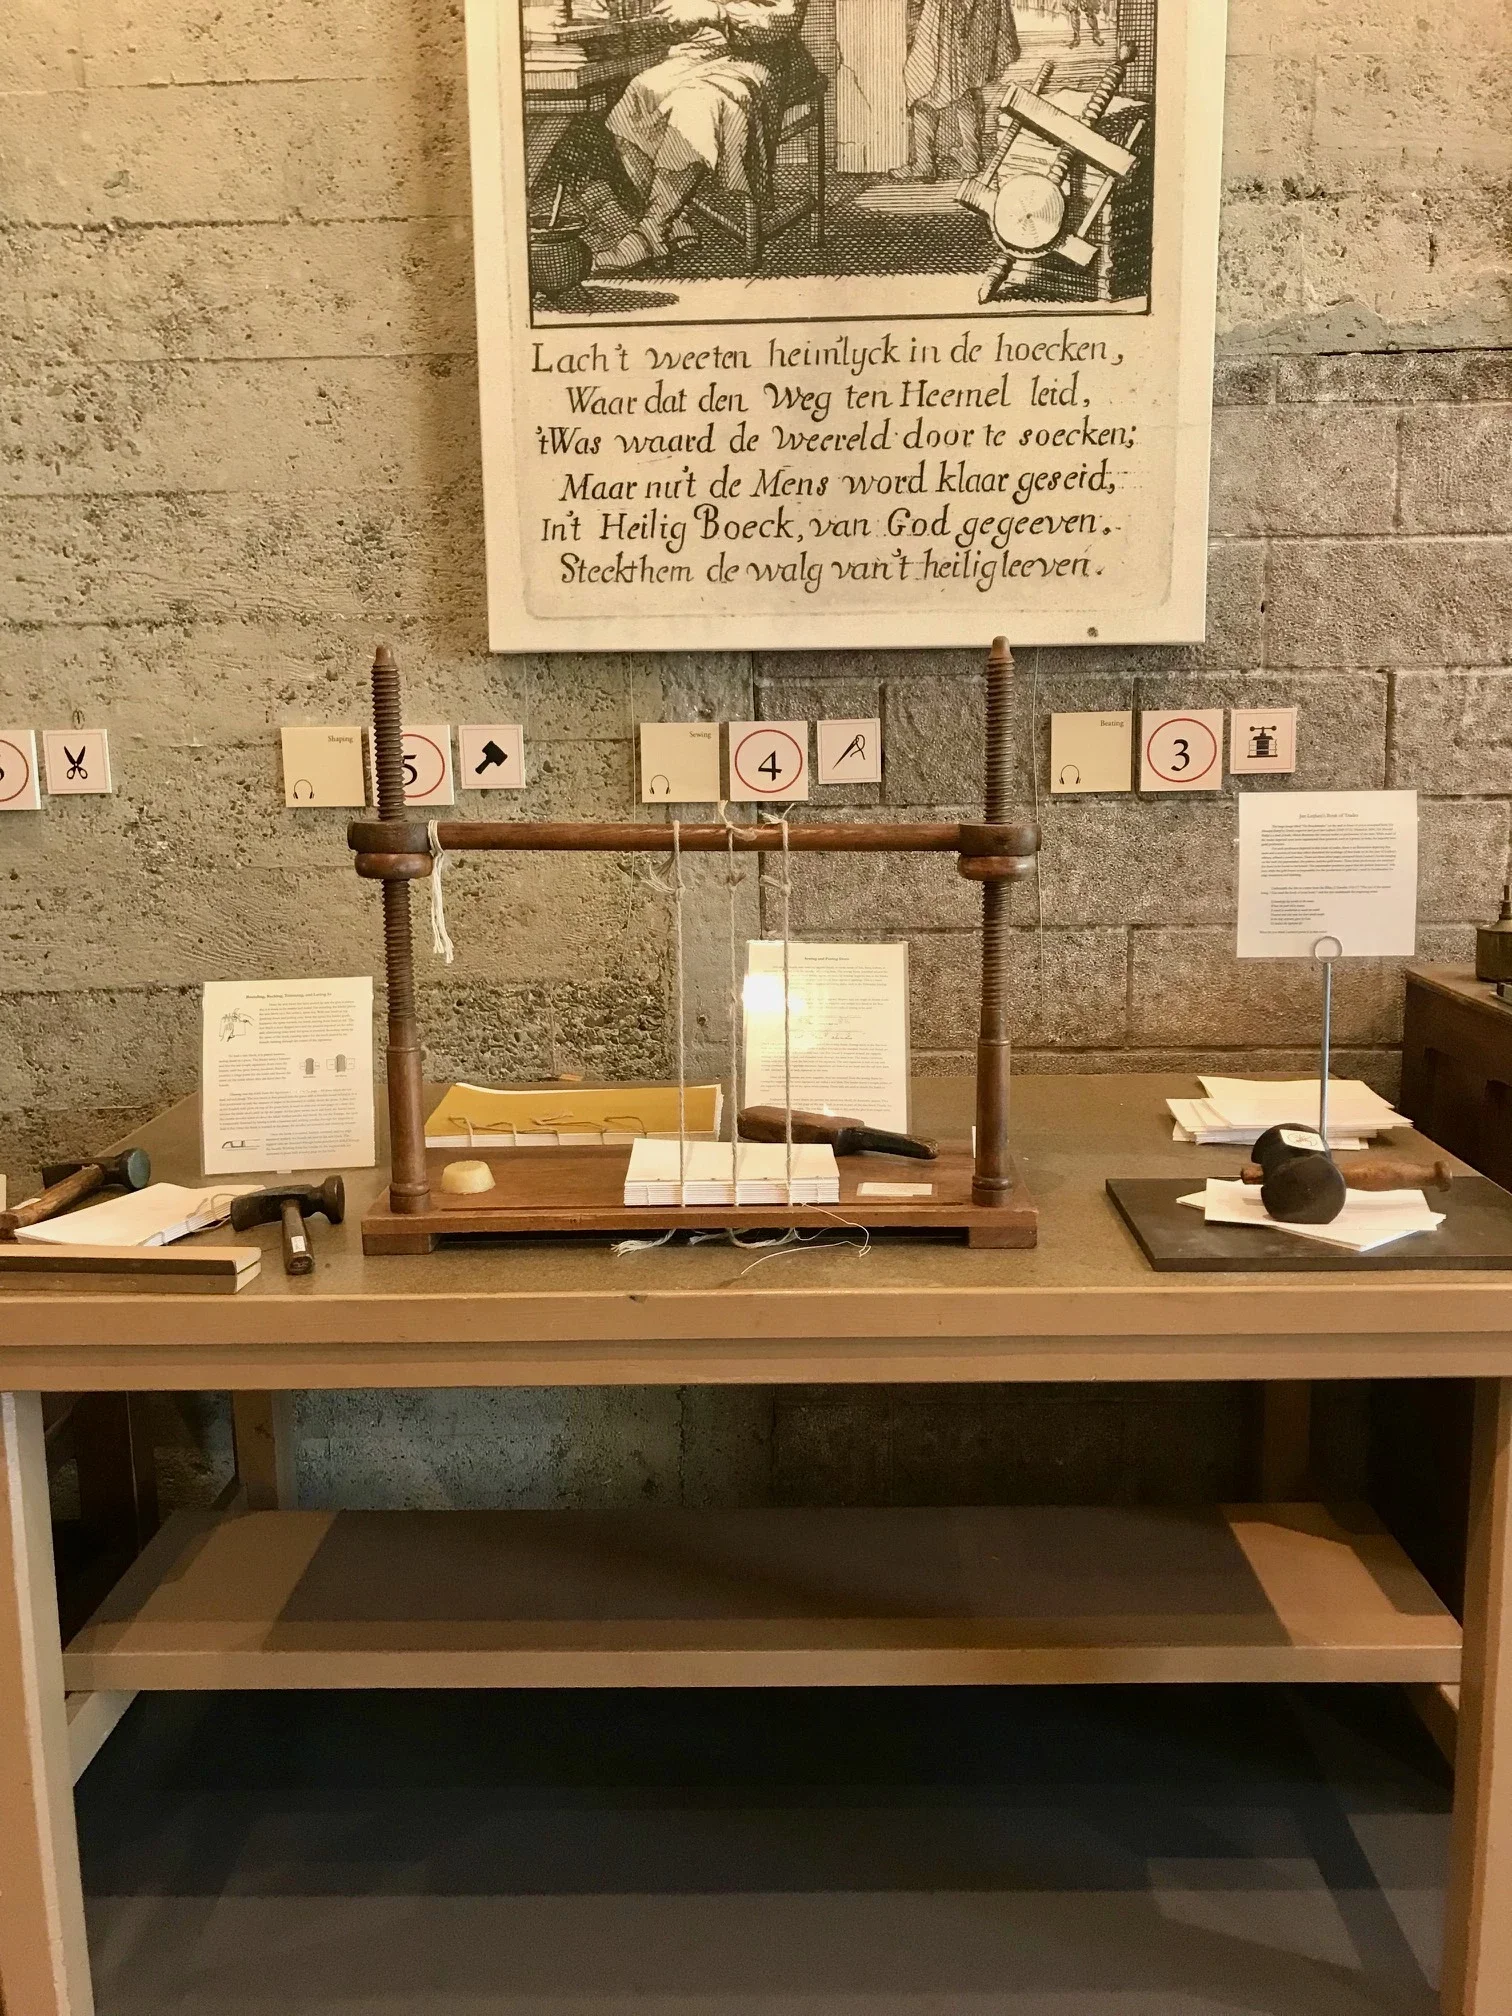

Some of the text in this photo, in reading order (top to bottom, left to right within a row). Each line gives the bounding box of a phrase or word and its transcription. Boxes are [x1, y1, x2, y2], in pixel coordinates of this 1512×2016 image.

[645, 346, 751, 370] weeten
[909, 337, 940, 363] in
[950, 331, 982, 363] de
[994, 328, 1124, 366] hoecken,
[566, 370, 1091, 422] Waar dat den Weg ten Heemel leid,
[614, 422, 716, 453] waard
[729, 421, 759, 452] de
[904, 416, 975, 448] door
[984, 422, 1006, 446] te
[558, 473, 637, 501] Maar
[709, 464, 741, 498] de
[750, 465, 828, 497] Mens
[842, 459, 927, 494] word
[935, 460, 1009, 493] klaar
[1012, 458, 1116, 505] geseid,
[600, 508, 686, 553] Heilig
[693, 503, 804, 542] Boeck,
[808, 519, 872, 537] van
[887, 503, 951, 537] God
[706, 551, 739, 583] de
[746, 551, 823, 593] walg
[831, 548, 911, 581] van't
[328, 735, 354, 744] Shaping
[689, 731, 711, 739] Sewing
[402, 754, 417, 785] 5
[758, 751, 782, 781] 4
[1171, 739, 1190, 771] 3
